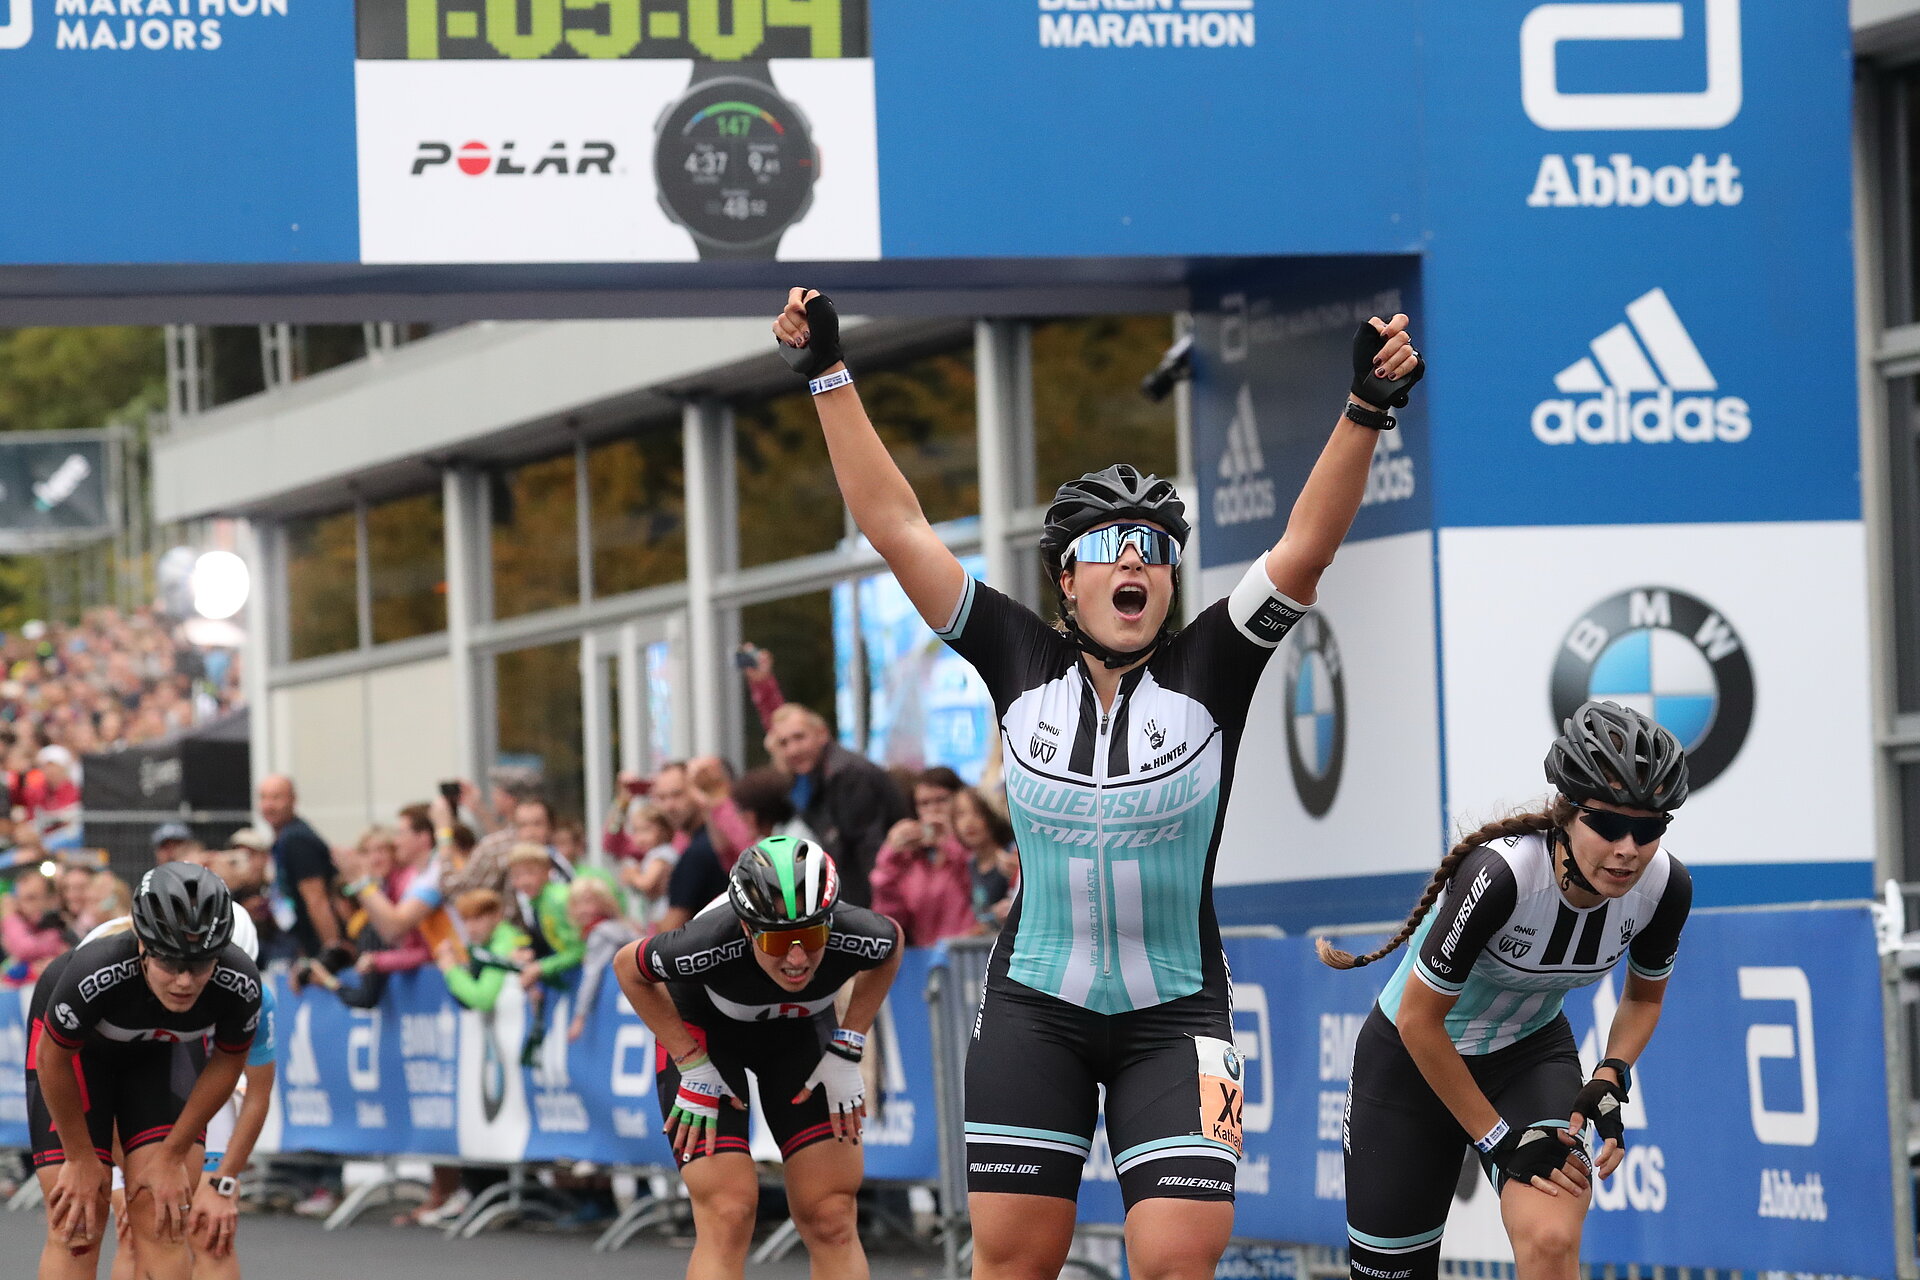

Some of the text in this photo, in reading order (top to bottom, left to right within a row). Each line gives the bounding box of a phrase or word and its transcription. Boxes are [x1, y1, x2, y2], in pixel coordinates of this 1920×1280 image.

[56, 19, 222, 50] MAJORS
[1039, 12, 1256, 48] MARATHON
[411, 141, 617, 176] POLAR
[1526, 153, 1744, 207] Abbott
[1531, 386, 1752, 445] adidas
[1566, 590, 1738, 664] BMW
[1153, 741, 1188, 769] HUNTER
[1008, 763, 1201, 820] POWERSLIDE
[1024, 815, 1185, 849] MATTER
[1440, 865, 1492, 961] POWERSLIDE
[675, 937, 748, 976] BONT
[212, 965, 260, 1003] ONT
[969, 1162, 1042, 1176] POWERSLIDE
[1157, 1175, 1233, 1193] POWERSLIDE
[1757, 1167, 1828, 1222] Abbott
[1351, 1258, 1413, 1280] POWERSLIDE
